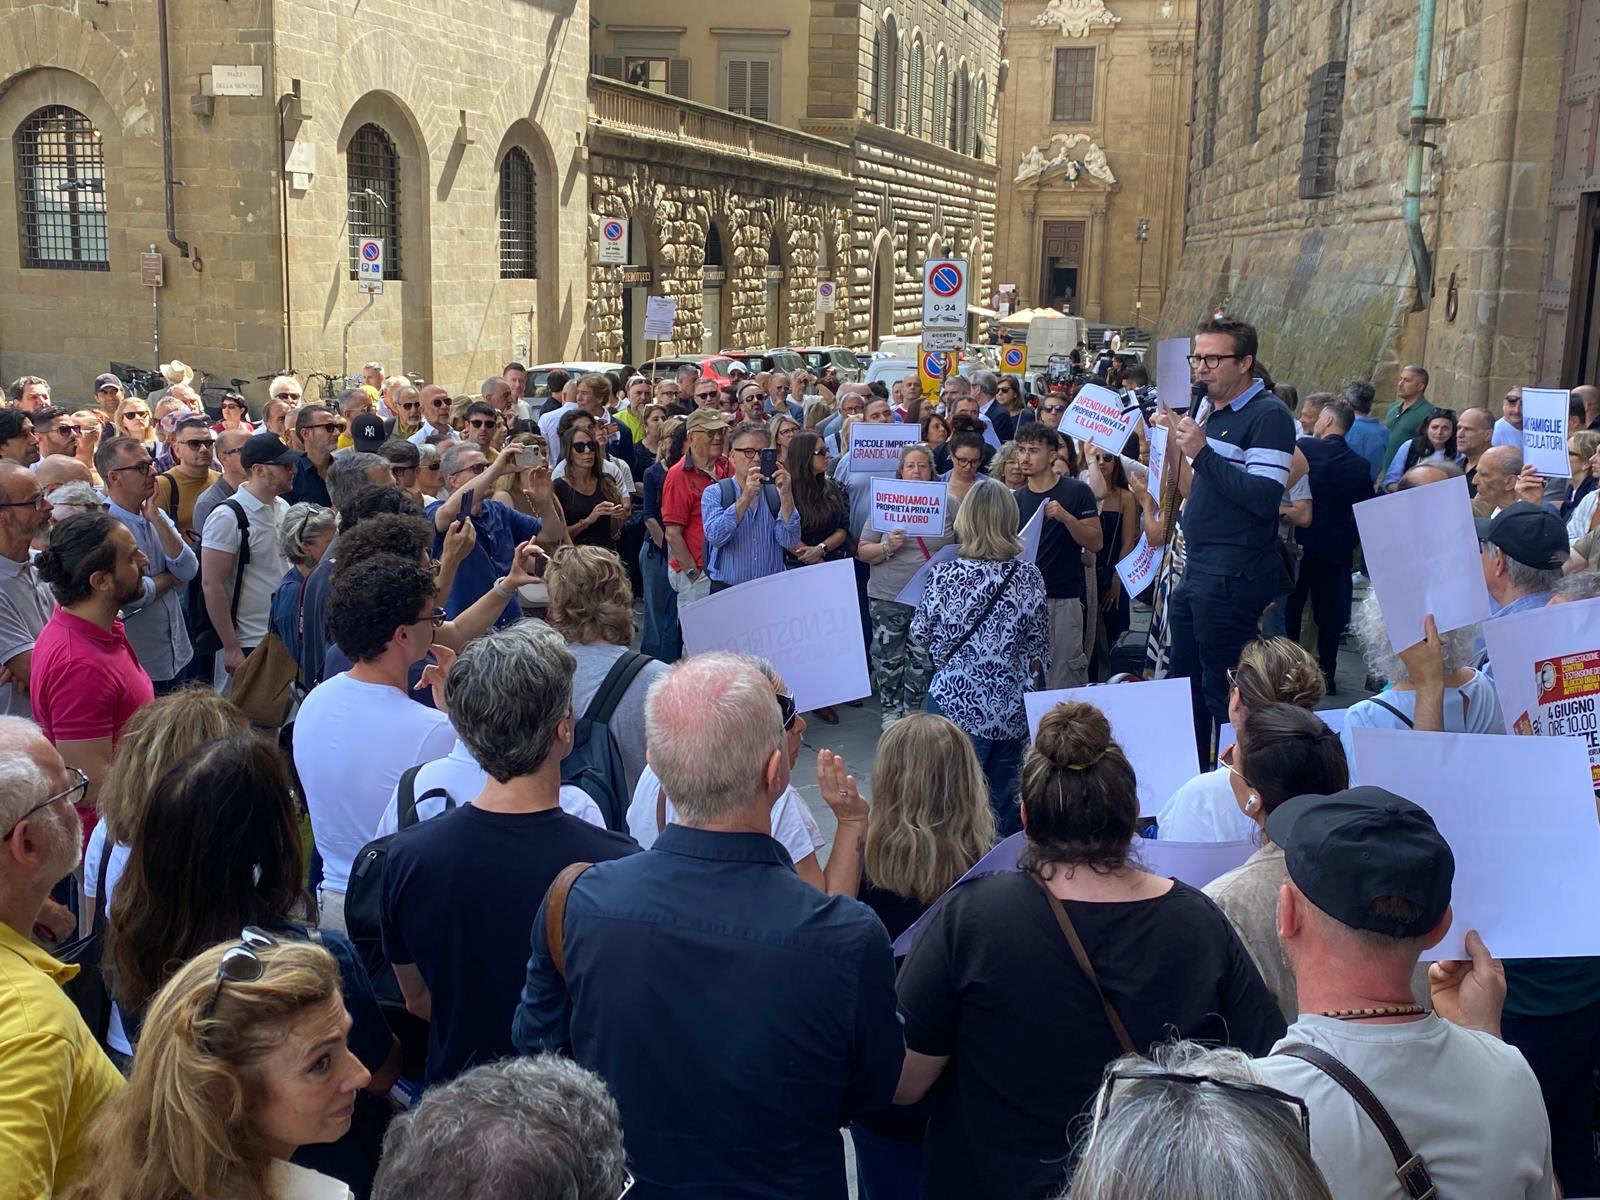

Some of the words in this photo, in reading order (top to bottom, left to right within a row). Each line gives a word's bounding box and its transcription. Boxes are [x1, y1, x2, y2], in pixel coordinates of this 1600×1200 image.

[1076, 395, 1120, 419] DIFENDIAMO
[1086, 420, 1114, 437] LAVORO
[1100, 416, 1126, 432] PRIVATA
[854, 440, 884, 448] PICCOLE
[853, 448, 885, 459] GRANDE
[876, 492, 928, 506] DIFENDIAMO
[929, 497, 940, 506] LA
[910, 505, 940, 515] PRIVATA
[884, 512, 889, 521] E
[889, 513, 896, 522] IL
[896, 514, 929, 524] LAVORO
[1548, 706, 1554, 720] 4
[1554, 698, 1595, 719] GIUGNO
[1548, 719, 1566, 737] ORE
[1566, 713, 1597, 733] 10.00
